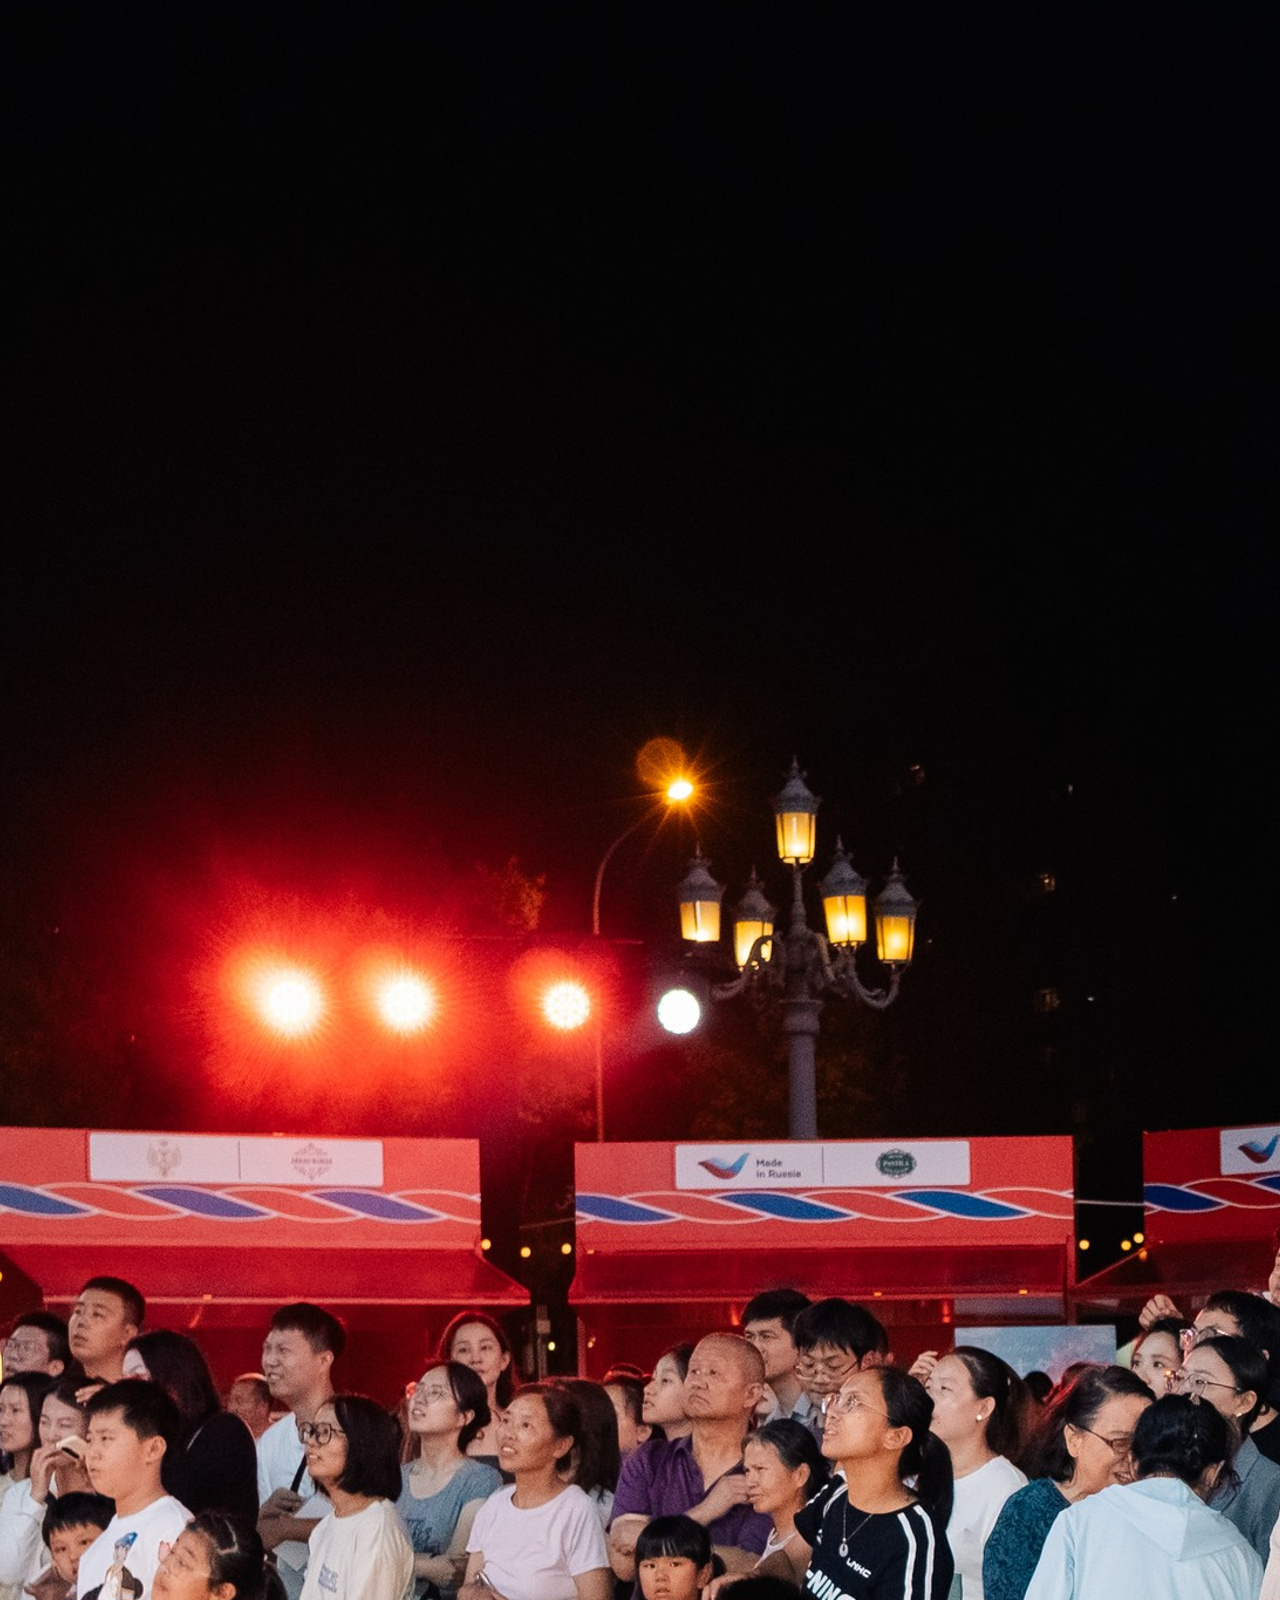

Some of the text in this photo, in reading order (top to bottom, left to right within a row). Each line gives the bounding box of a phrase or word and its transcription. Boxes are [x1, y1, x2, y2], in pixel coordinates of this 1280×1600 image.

[756, 1159, 783, 1167] Made
[756, 1169, 802, 1178] in Russia
